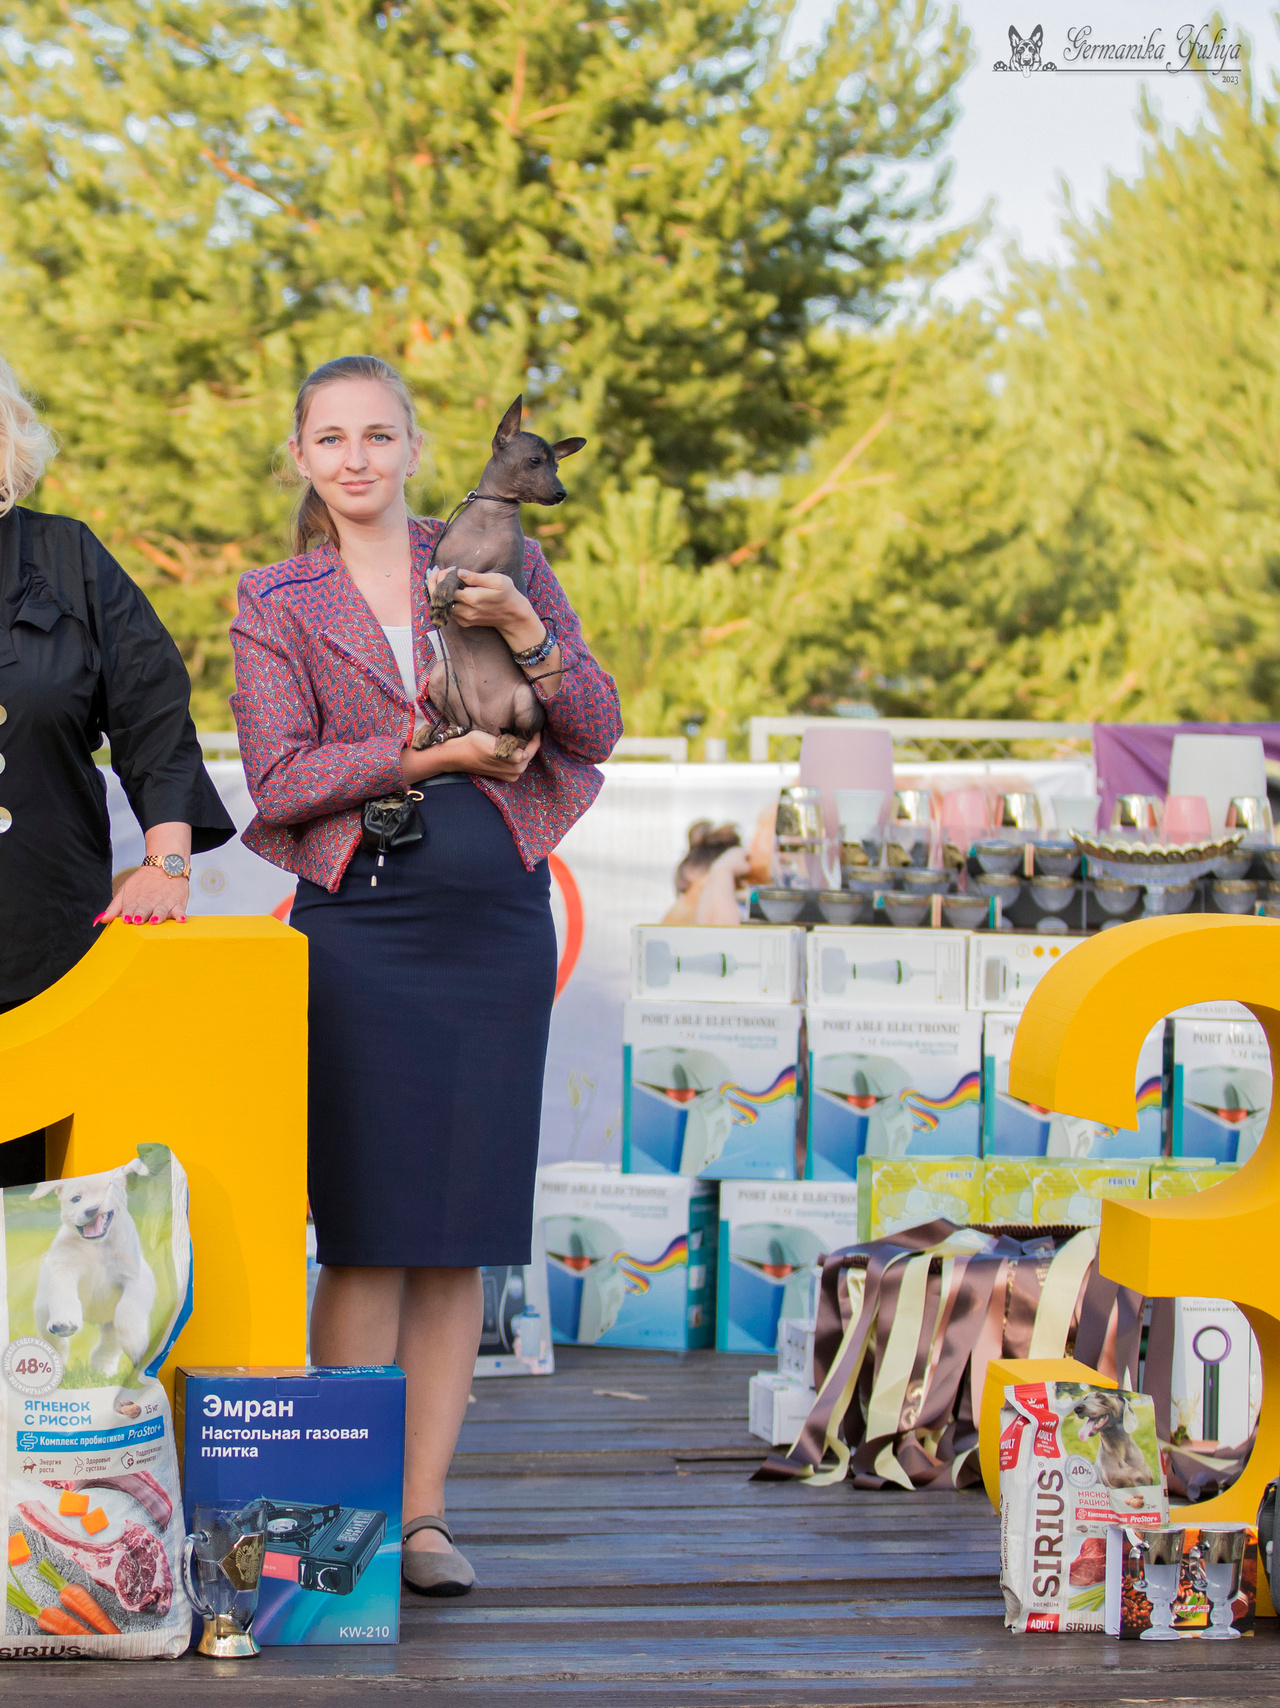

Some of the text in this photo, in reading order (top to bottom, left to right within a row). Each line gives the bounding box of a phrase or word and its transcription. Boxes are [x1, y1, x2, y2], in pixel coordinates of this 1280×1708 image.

[706, 1015, 779, 1028] ELECTRONIC
[887, 1022, 960, 1034] ELECTRONIC
[15, 1358, 52, 1374] 48%
[24, 1400, 91, 1413] ЯГНЕНОК
[202, 1394, 294, 1422] Эмран
[24, 1414, 92, 1426] С РИСОМ
[40, 1424, 162, 1447] Комплекс пробиотиков ProStor+
[202, 1426, 368, 1440] Настольная газовая
[1037, 1430, 1052, 1442] ADULT
[202, 1446, 258, 1458] плитка
[39, 1458, 62, 1466] Энергия
[86, 1456, 111, 1465] Здоровые
[1072, 1466, 1091, 1475] 40%
[1079, 1499, 1111, 1507] РАЦИОН
[1032, 1469, 1064, 1598] SIRIUS
[1030, 1620, 1055, 1630] ADULT
[1066, 1622, 1104, 1632] SIRIUS
[339, 1626, 389, 1638] KW-210
